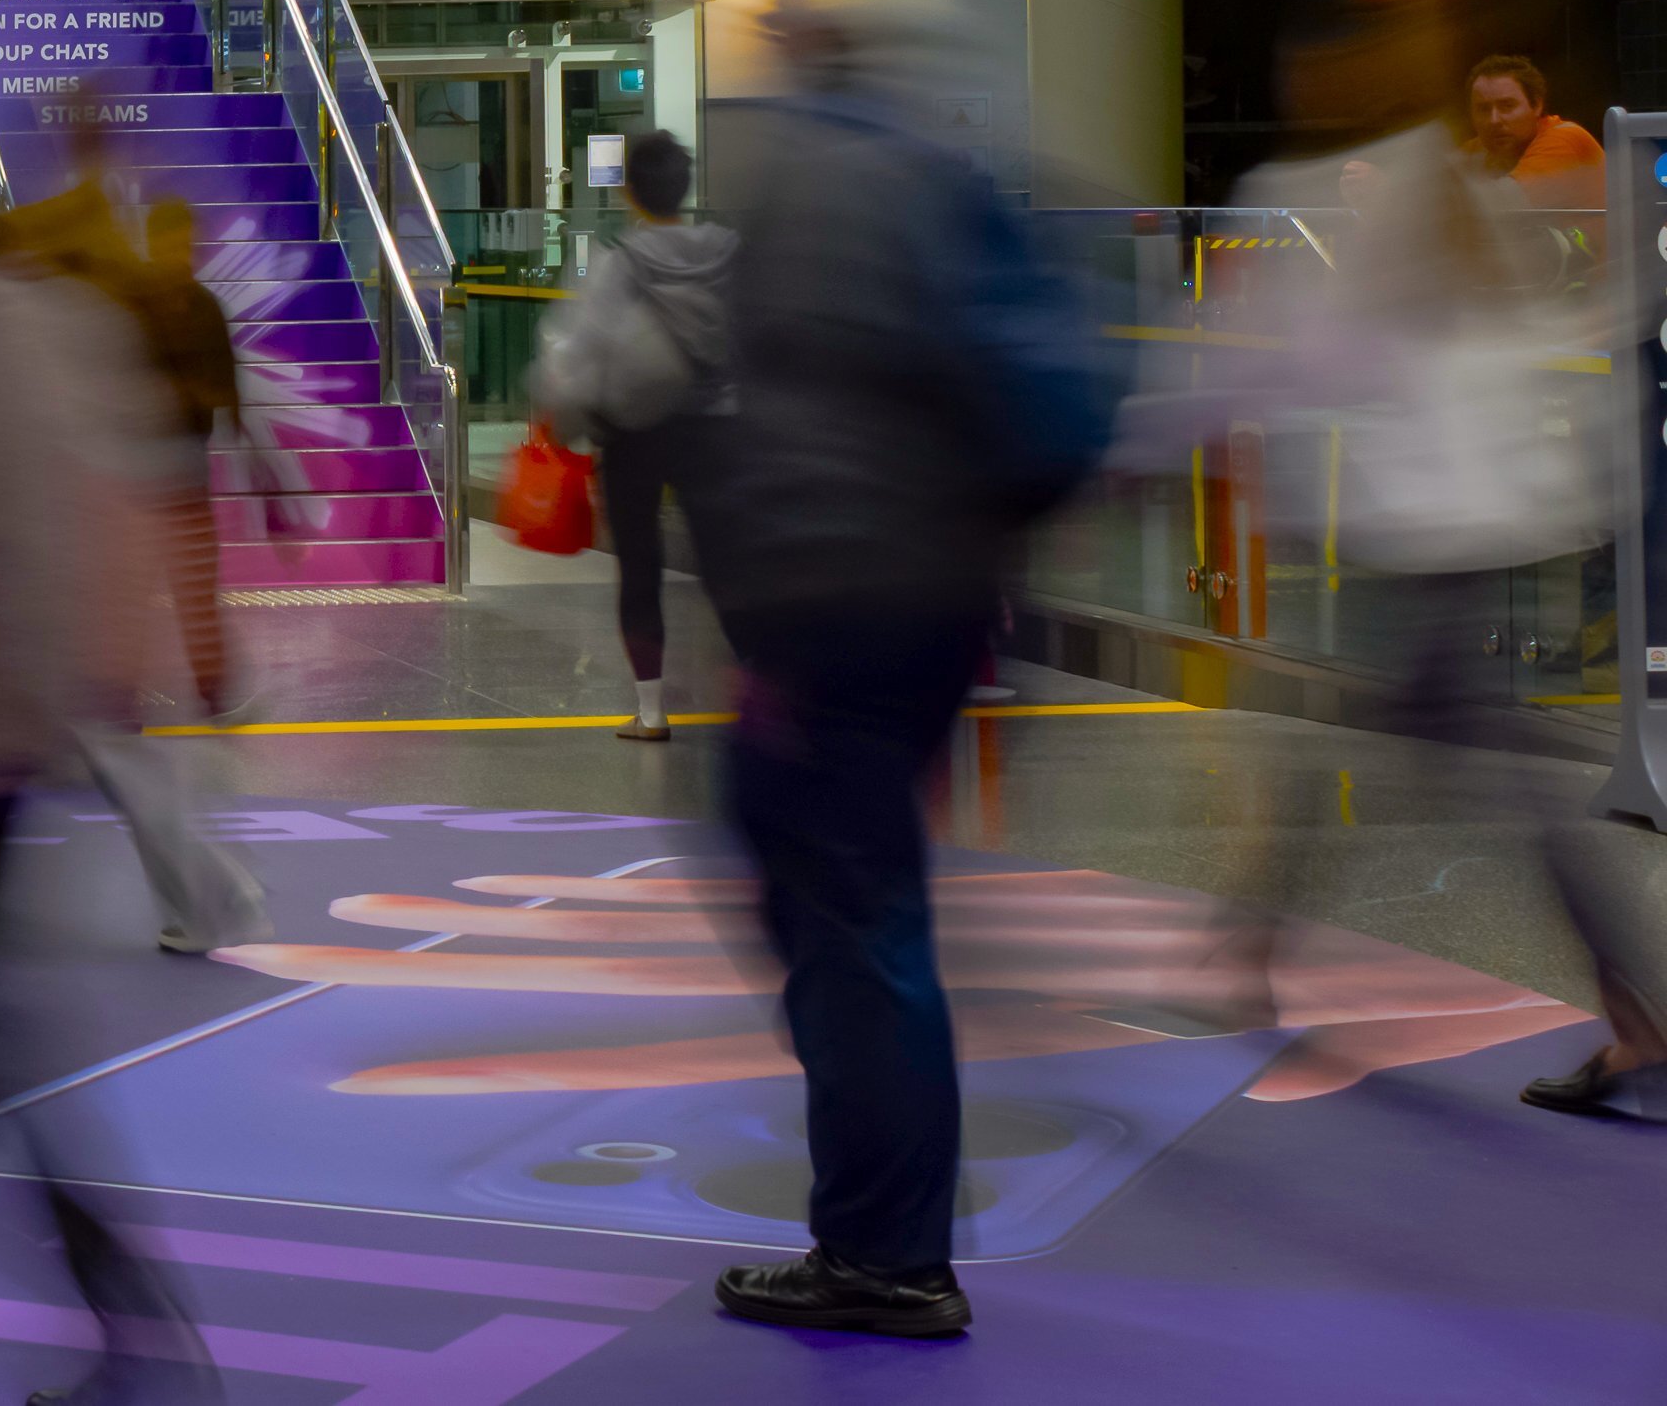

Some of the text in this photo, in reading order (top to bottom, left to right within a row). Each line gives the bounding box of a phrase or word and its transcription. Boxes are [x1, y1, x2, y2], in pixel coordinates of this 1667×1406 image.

[14, 12, 57, 30] FOR
[63, 12, 79, 30] A
[86, 11, 165, 29] FRIEND
[40, 43, 109, 61] CHATS
[2, 76, 80, 94] MEMES
[40, 104, 149, 124] STREAMS
